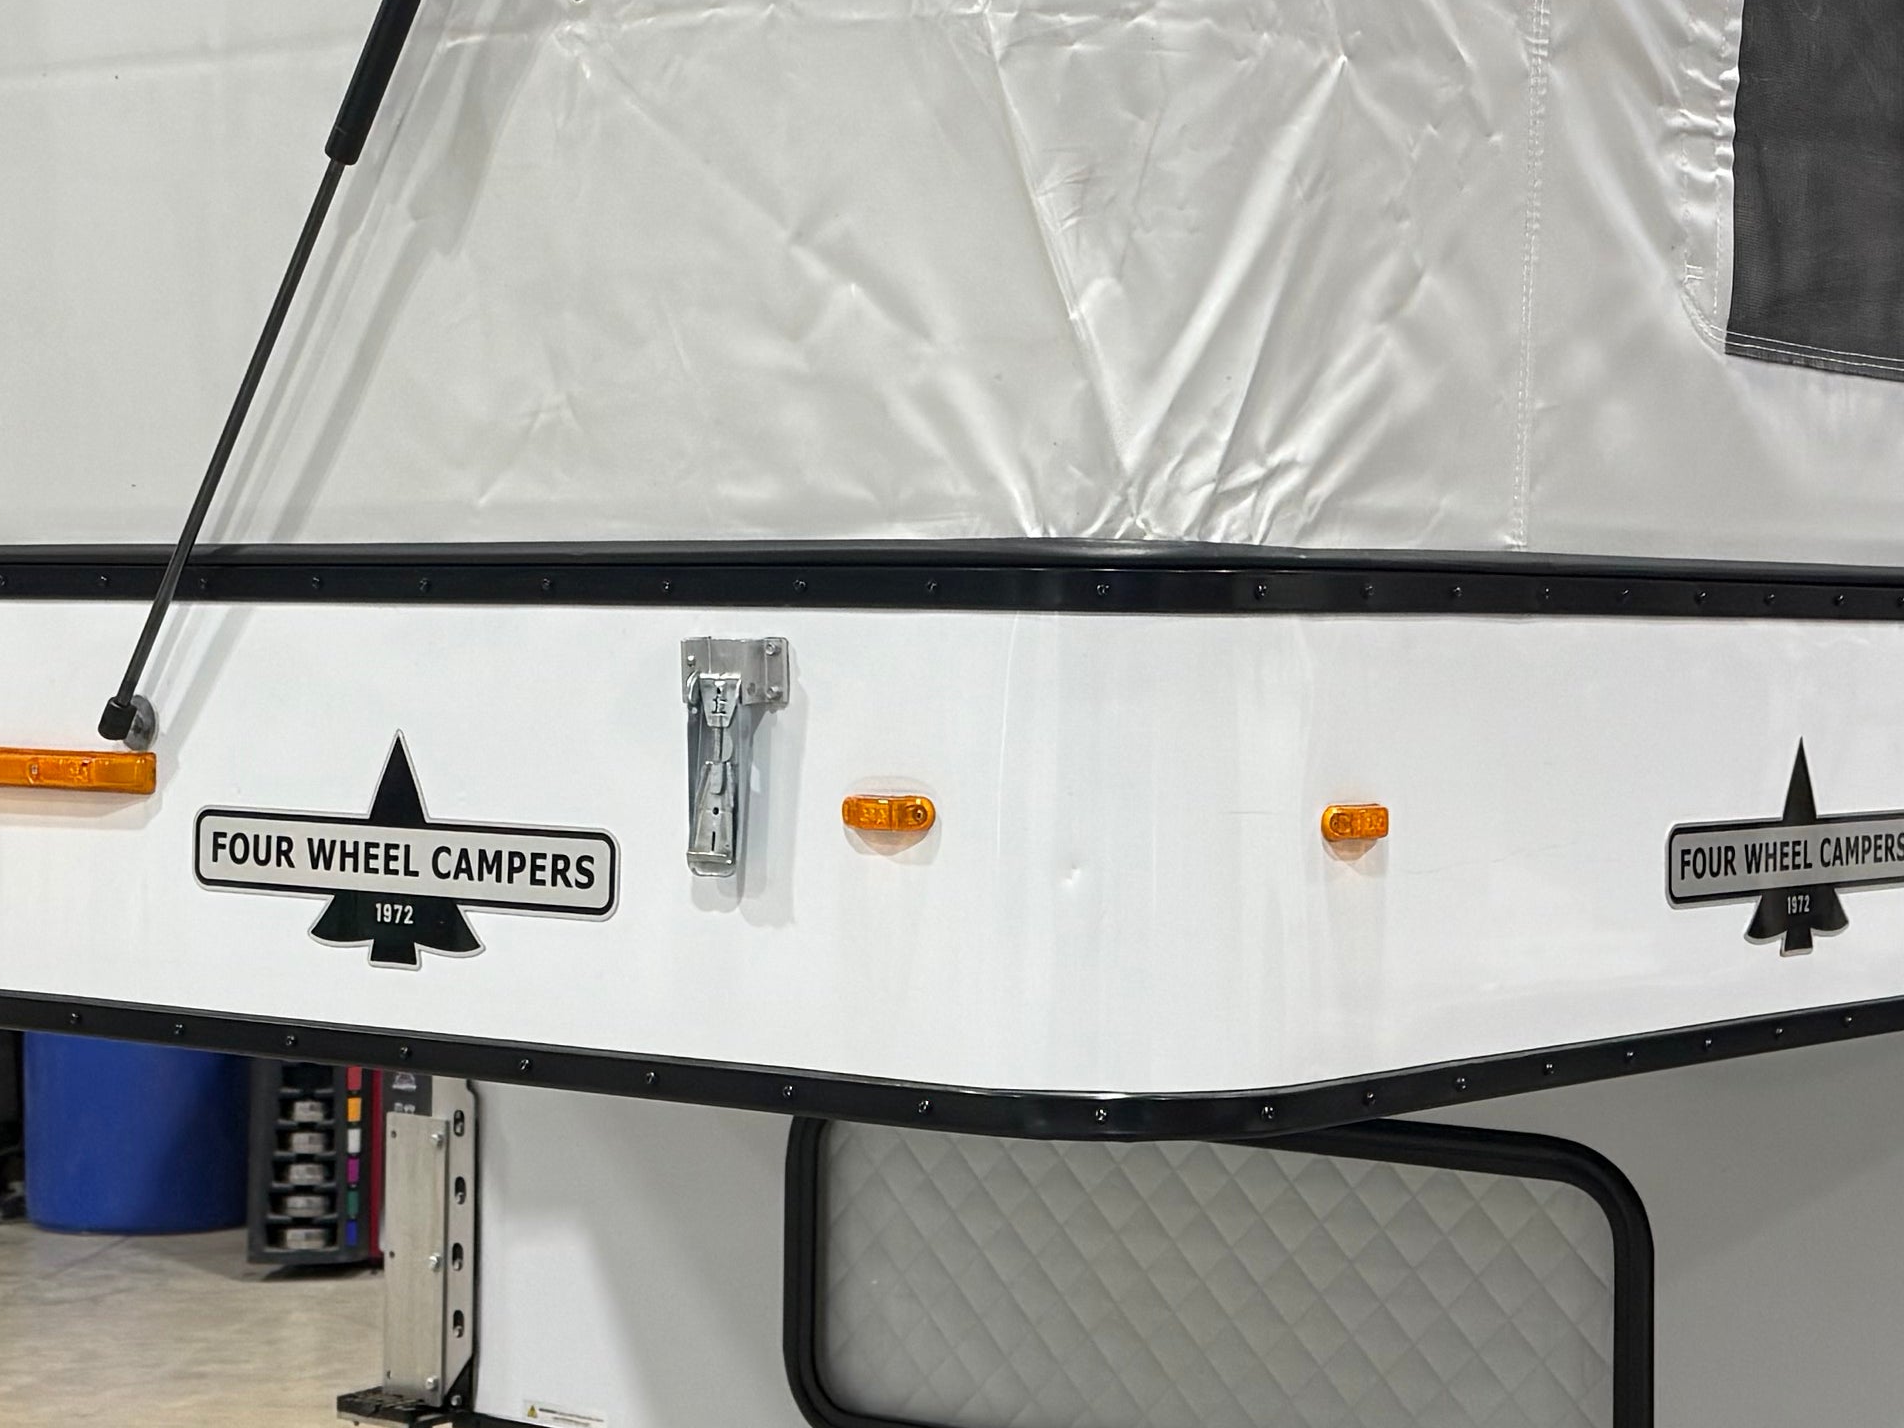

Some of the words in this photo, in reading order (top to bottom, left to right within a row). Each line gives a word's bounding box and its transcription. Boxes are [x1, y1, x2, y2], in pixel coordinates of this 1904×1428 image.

[211, 831, 295, 868] FOUR
[307, 837, 420, 878] WHEEL
[431, 846, 595, 890] CAMPERS
[1680, 845, 1737, 880] FOUR
[1744, 839, 1813, 874] WHEEL
[375, 902, 414, 925] 1972
[1787, 895, 1810, 914] 1972
